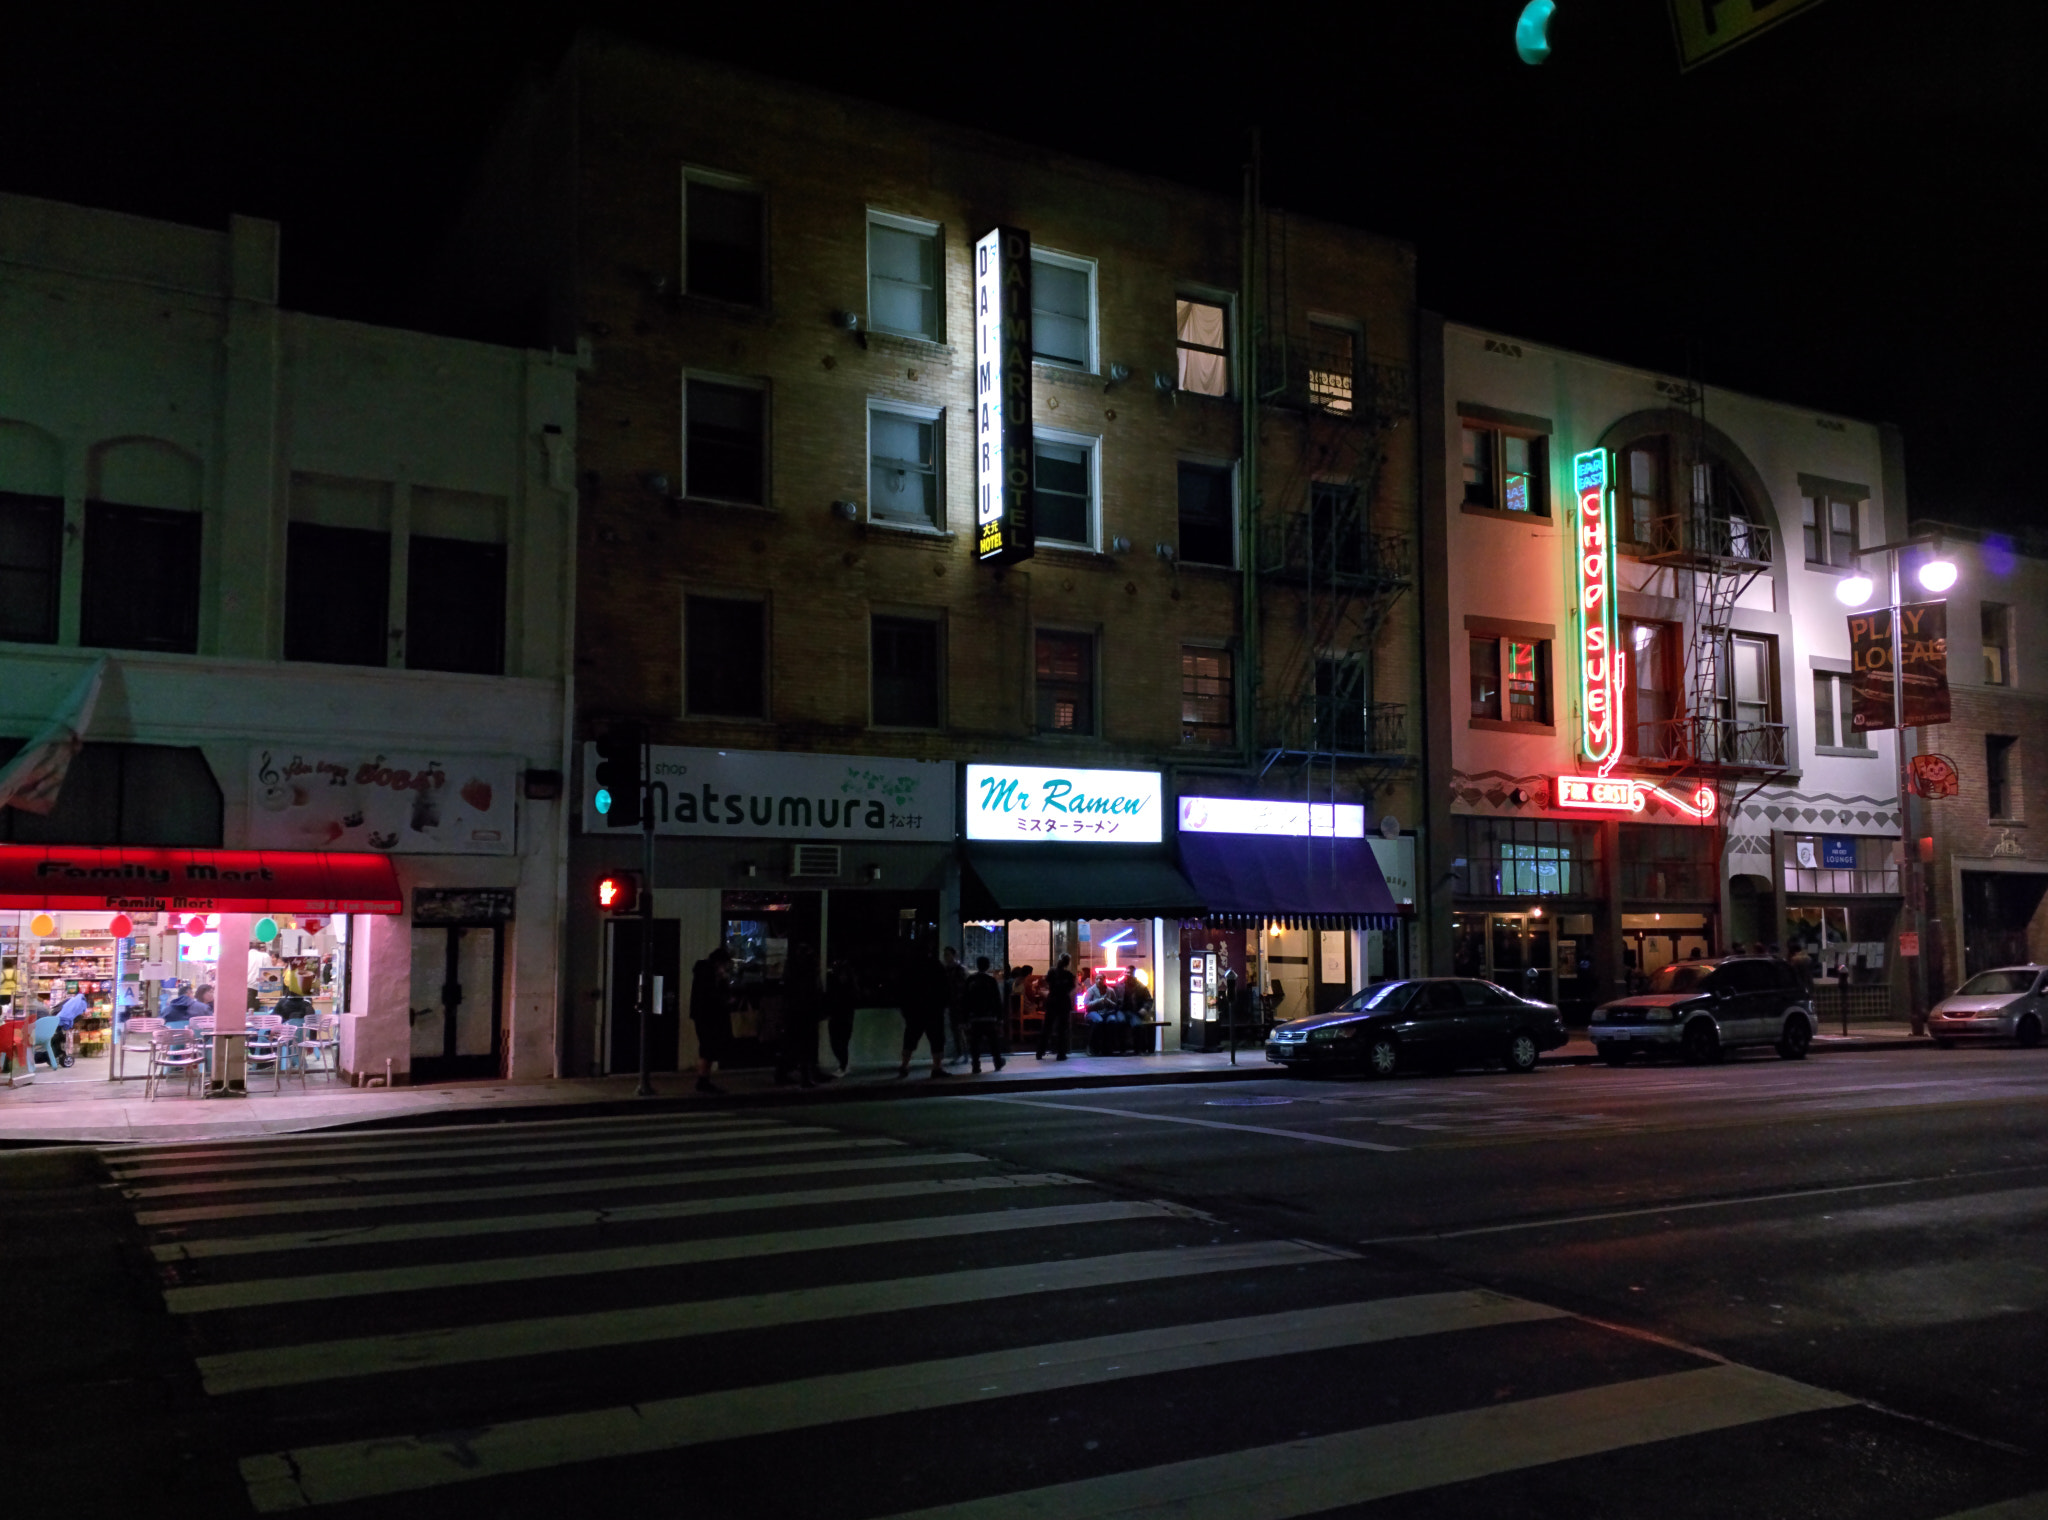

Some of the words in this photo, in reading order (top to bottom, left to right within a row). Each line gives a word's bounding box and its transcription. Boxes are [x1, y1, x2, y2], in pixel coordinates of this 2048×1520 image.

[1006, 234, 1027, 426] DAIMARU
[980, 245, 991, 514] DAIMARU
[1007, 447, 1029, 548] HOTEL
[980, 532, 1002, 553] HOTEL
[1582, 493, 1605, 608] CHOP
[1852, 608, 1925, 643] PLAY
[1586, 627, 1608, 743] SUEY
[654, 762, 687, 775] shop
[980, 777, 1031, 812] Mr
[1042, 779, 1151, 815] Ramen
[889, 813, 923, 829] 松村
[1017, 818, 1119, 833] ミスターラーメン
[37, 862, 170, 883] Family
[186, 864, 274, 881] Mart
[106, 896, 166, 911] Family
[173, 897, 214, 908] Mart
[124, 987, 134, 997] A
